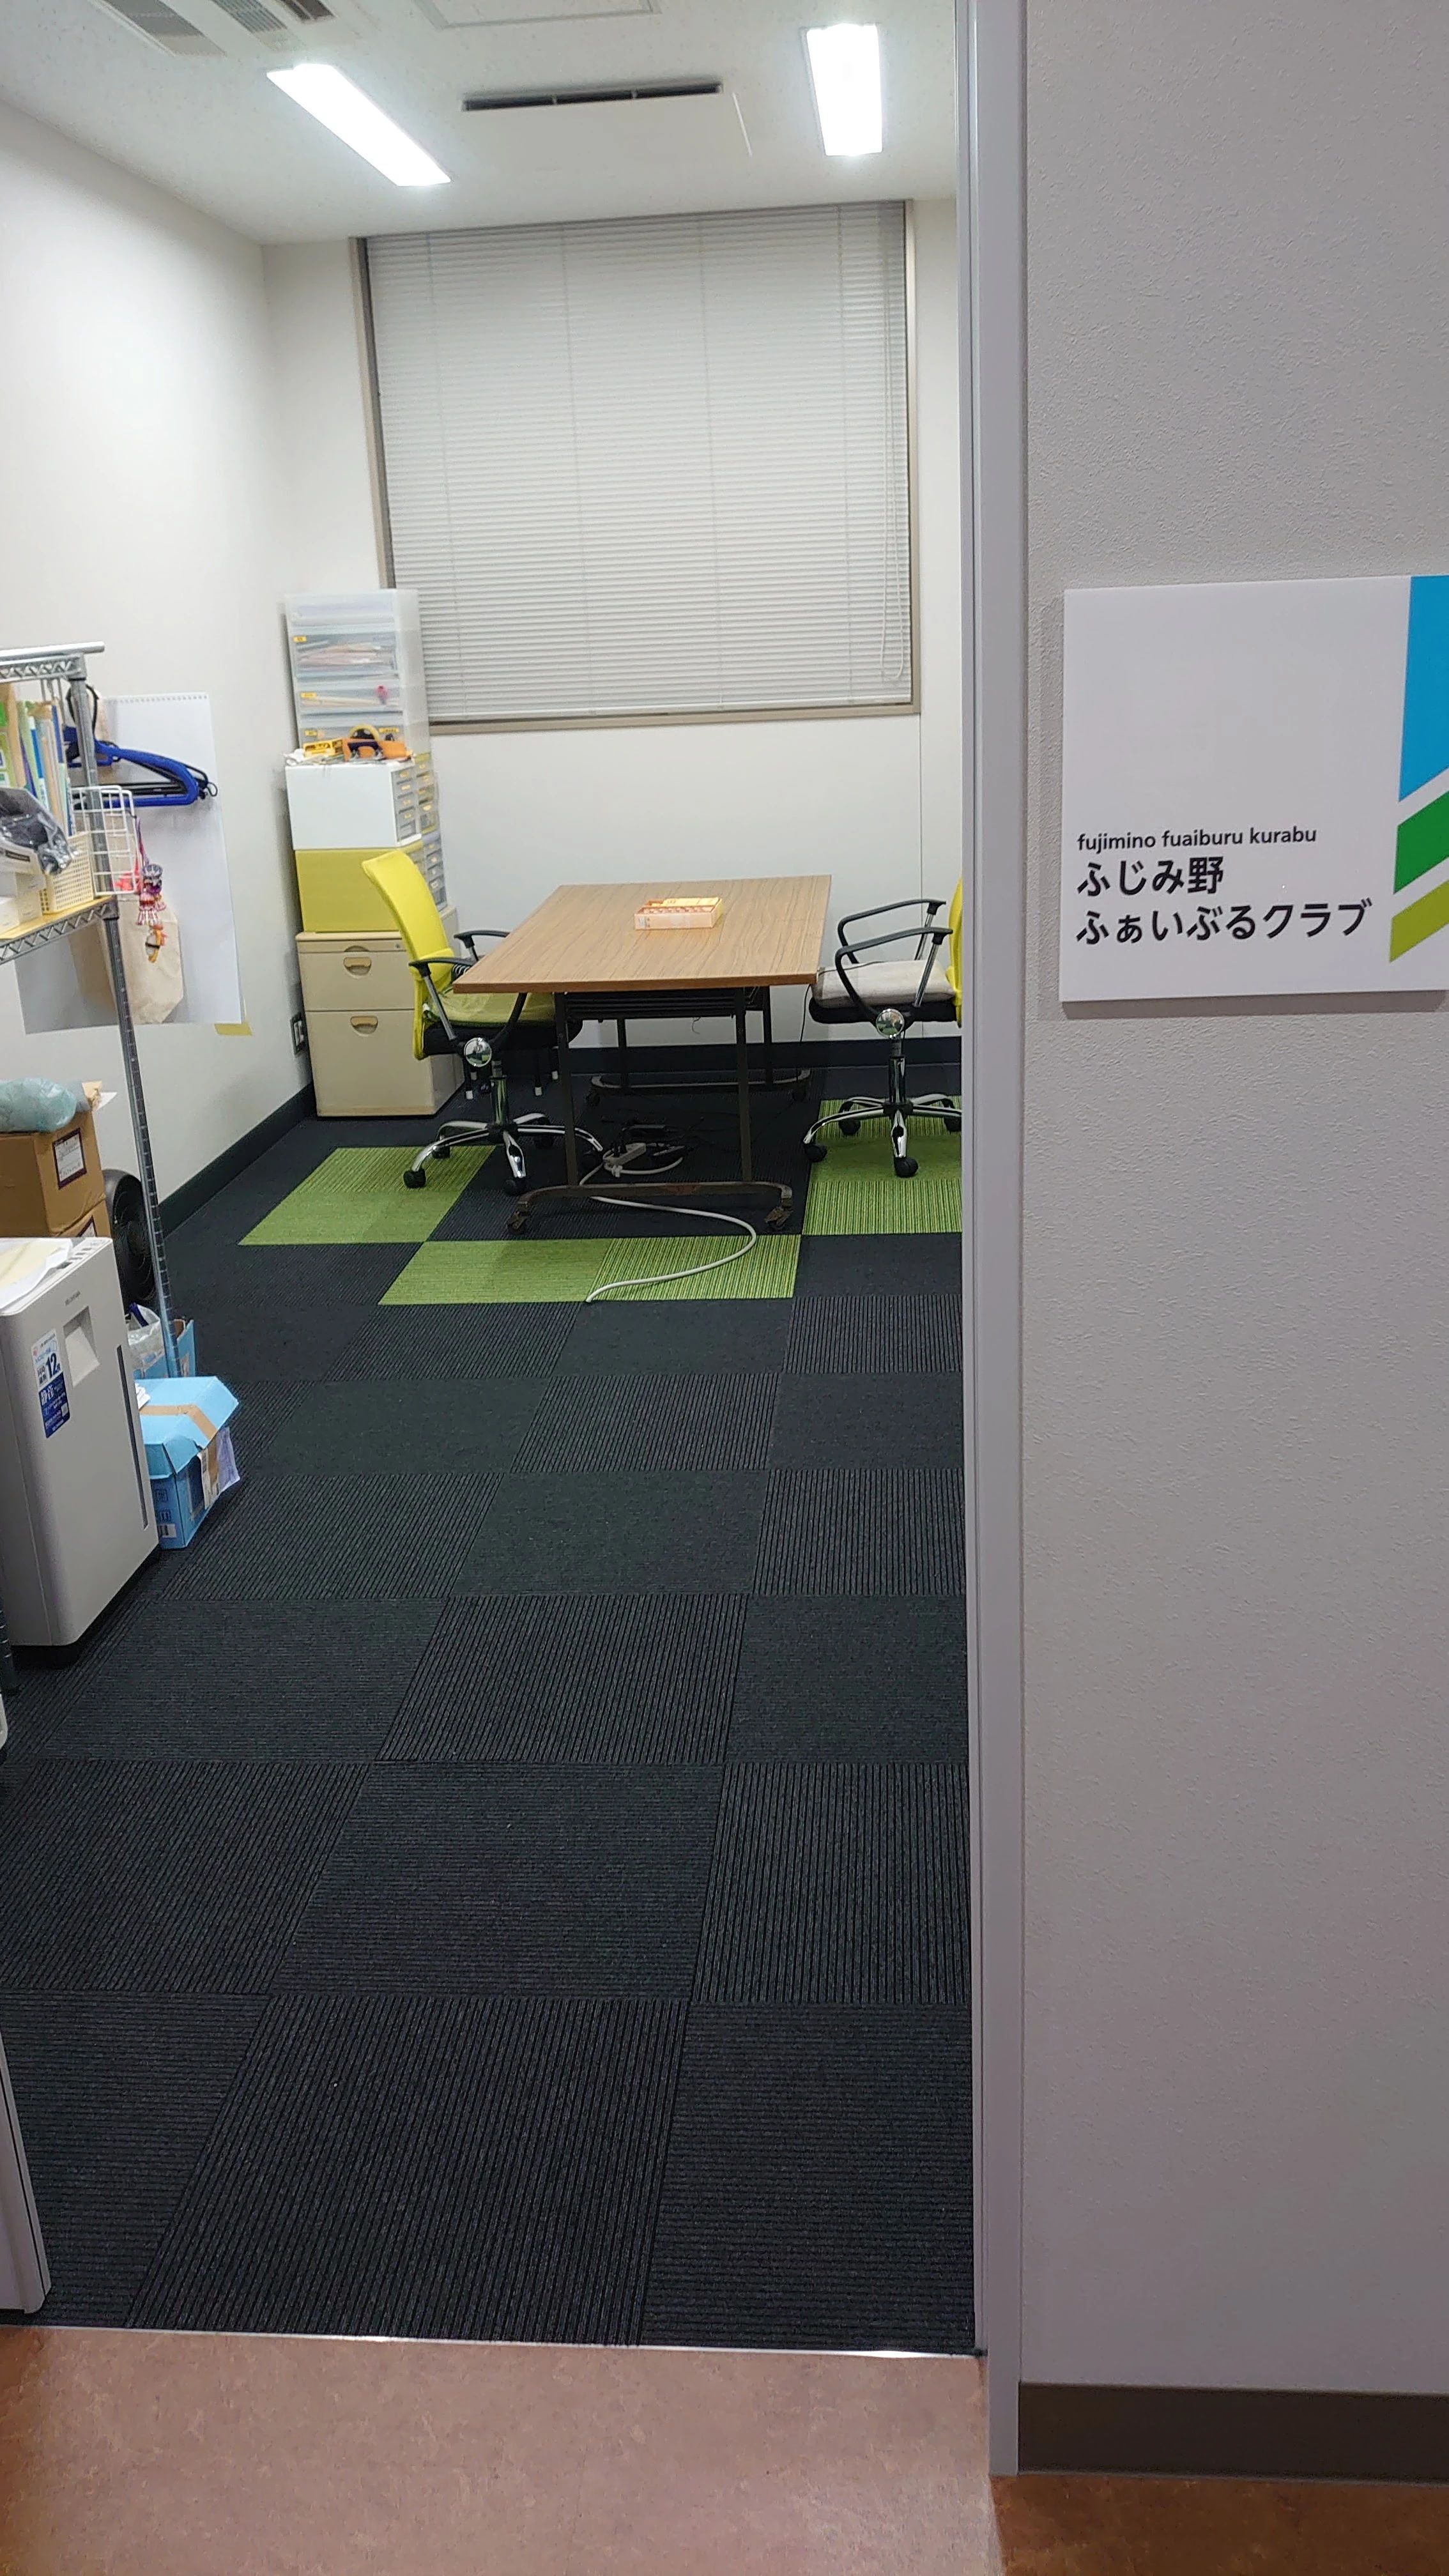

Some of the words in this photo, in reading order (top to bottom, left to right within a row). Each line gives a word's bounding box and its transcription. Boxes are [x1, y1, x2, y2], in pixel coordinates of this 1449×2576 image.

[1077, 832, 1156, 854] fujimino
[1162, 829, 1243, 848] fuaiburu
[1250, 825, 1317, 844] kurabu
[1077, 856, 1223, 896] ふじみ野
[1077, 898, 1373, 945] ふぁいぶるクラブ
